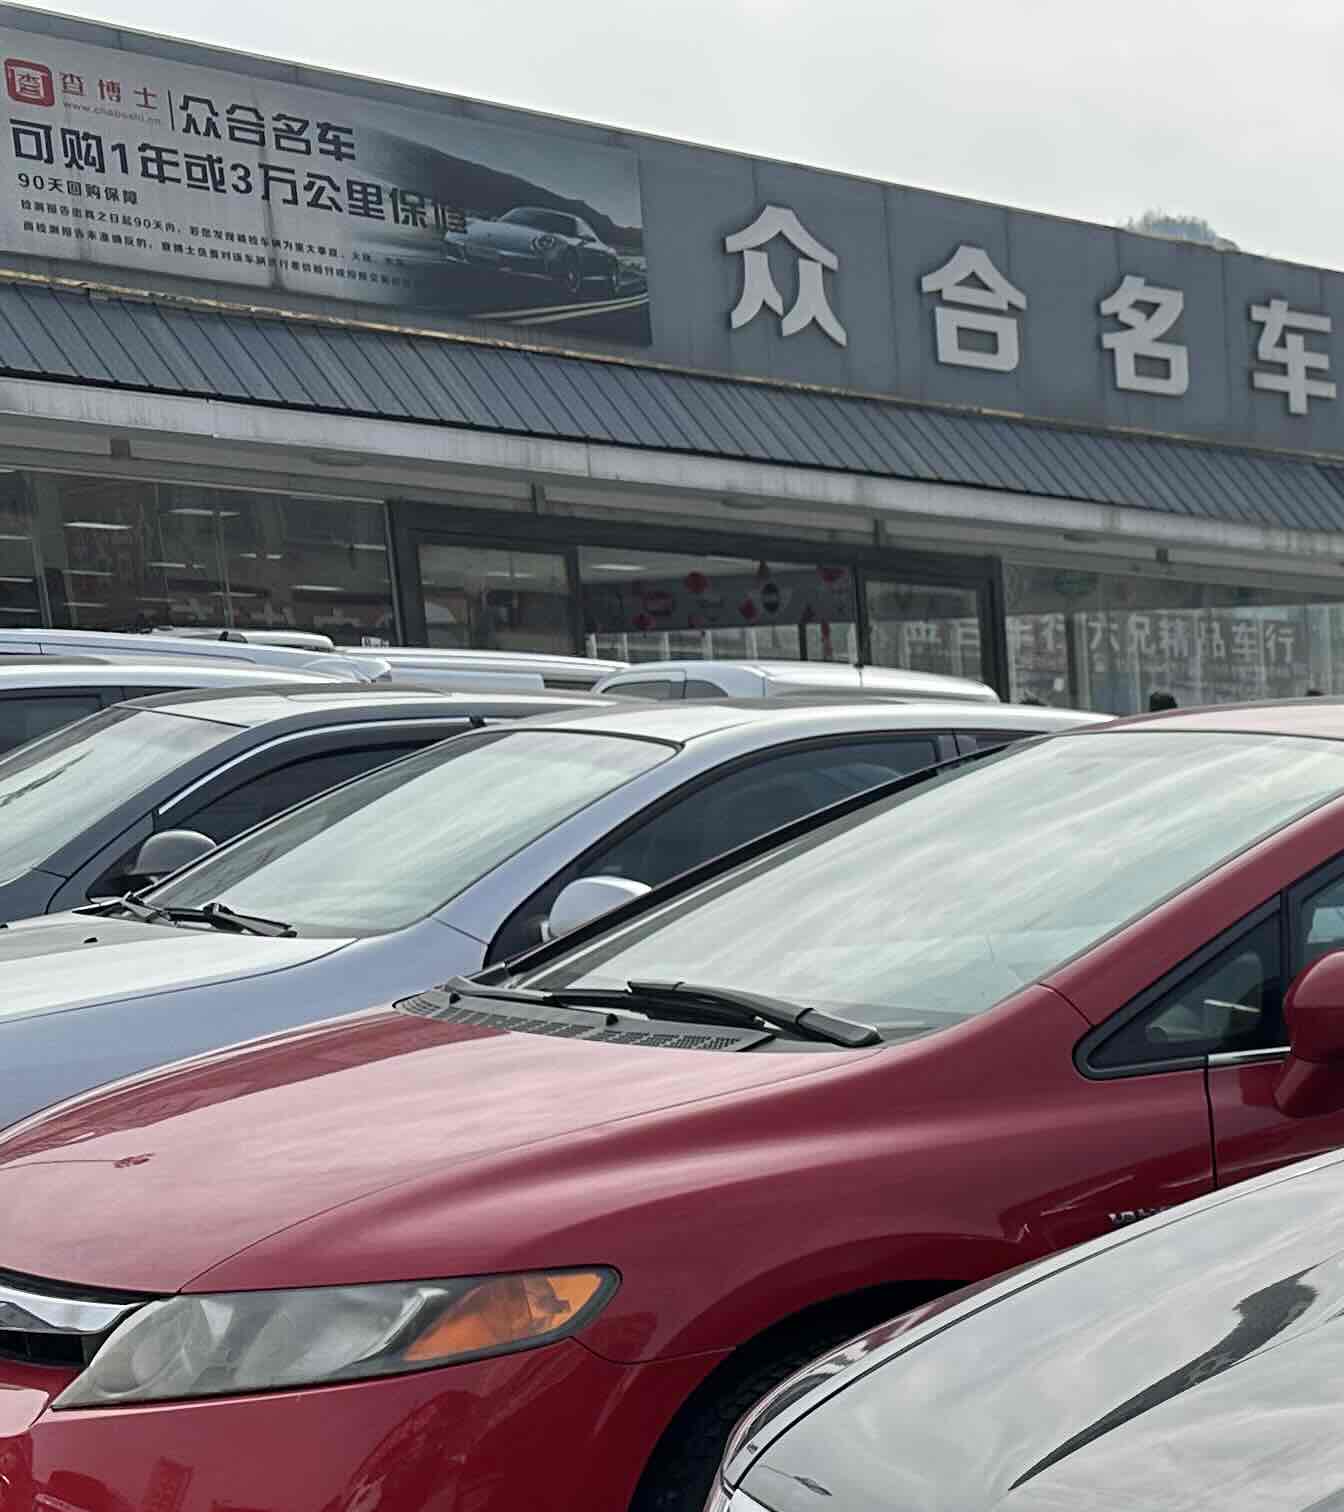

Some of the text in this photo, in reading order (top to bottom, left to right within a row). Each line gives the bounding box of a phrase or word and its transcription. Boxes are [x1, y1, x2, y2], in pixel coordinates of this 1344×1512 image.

[179, 94, 357, 162] 众合名车
[17, 172, 138, 205] 90天回购保障
[725, 203, 1338, 416] 众合名车
